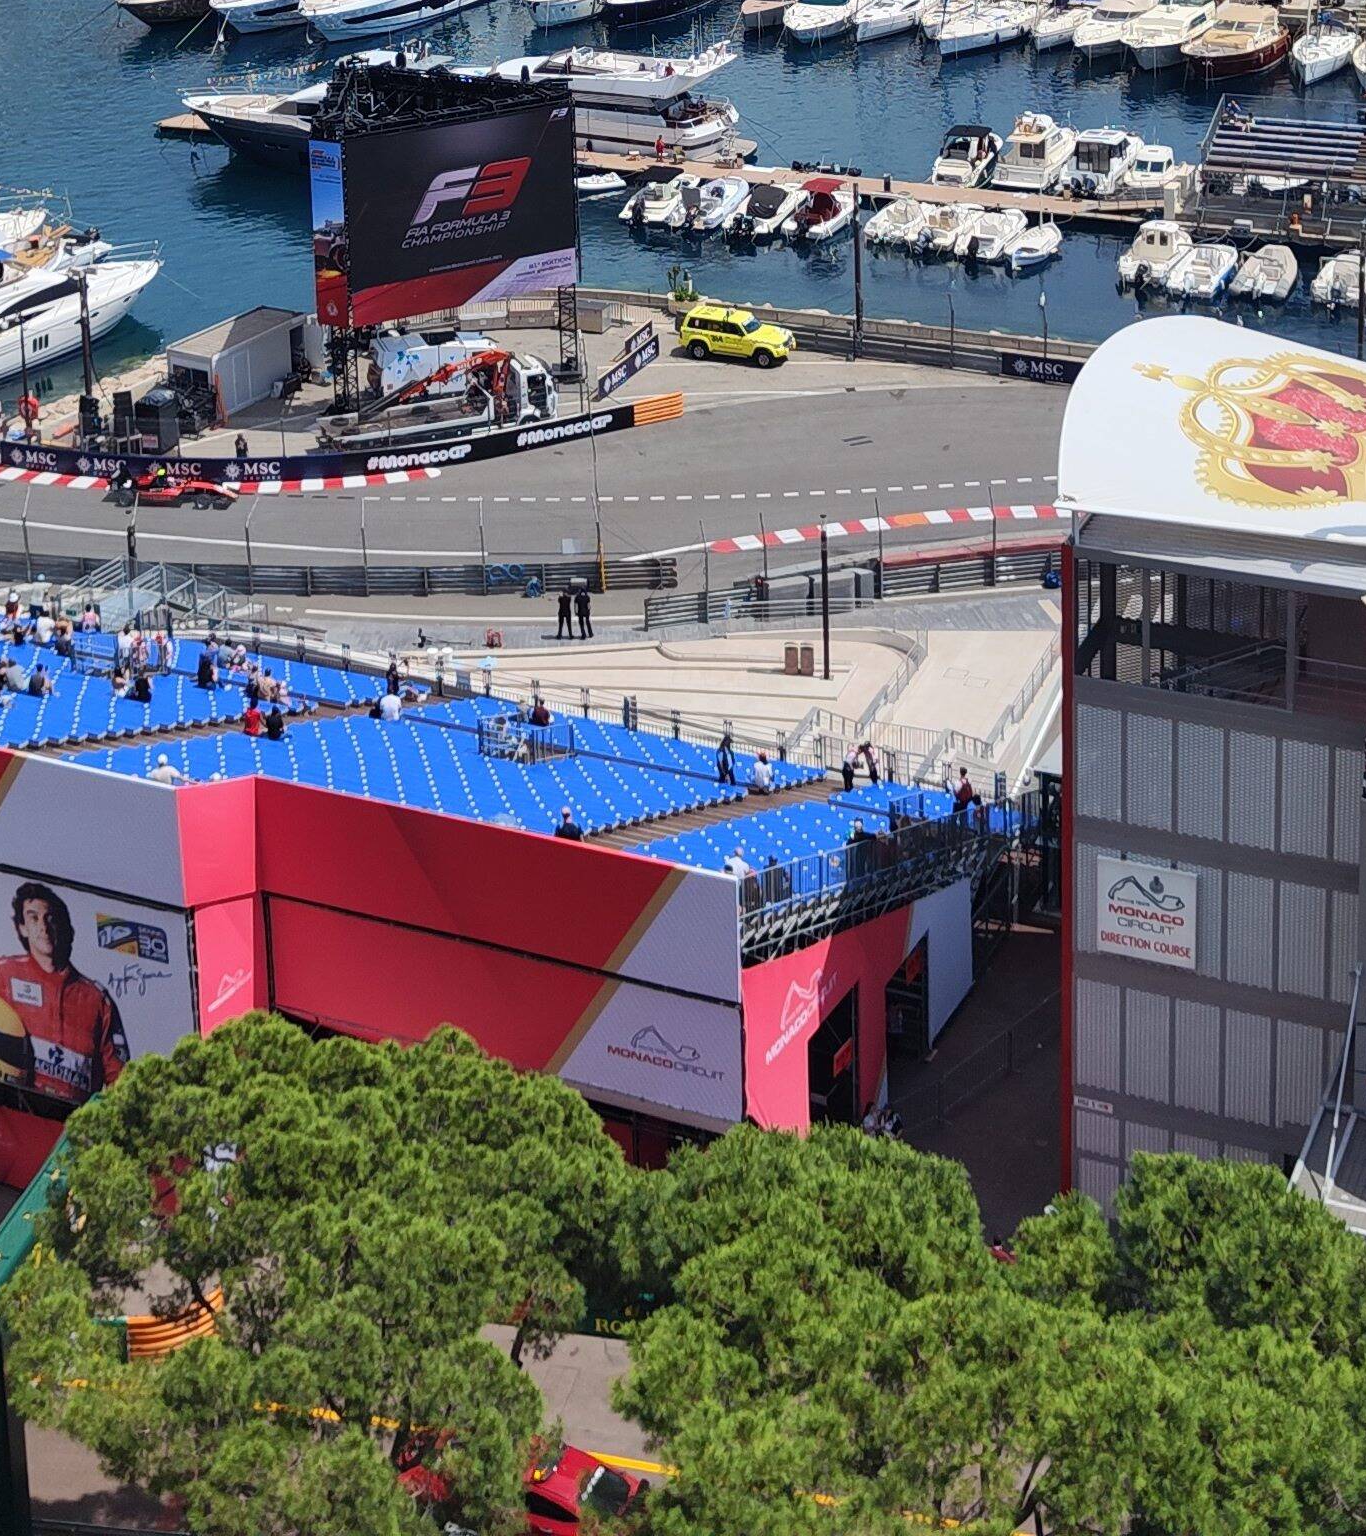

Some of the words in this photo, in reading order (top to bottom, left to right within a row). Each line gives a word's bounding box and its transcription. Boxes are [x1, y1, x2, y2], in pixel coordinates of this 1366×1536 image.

[411, 156, 532, 226] F3
[406, 223, 429, 240] FIA
[431, 213, 499, 237] FORMULA
[499, 210, 512, 222] 3
[401, 222, 509, 250] CHAMPIONSHIP
[640, 342, 656, 361] MSC
[611, 364, 627, 384] MSC
[1030, 361, 1064, 375] MSC
[25, 449, 57, 466] MSC
[93, 457, 127, 472] MSC
[167, 462, 202, 477] MSC
[244, 461, 281, 476] MSC
[1108, 903, 1185, 927] MONACO
[1117, 916, 1175, 936] CIRCUIT
[1100, 929, 1151, 950] DIRECTION
[1153, 941, 1192, 960] COURSE
